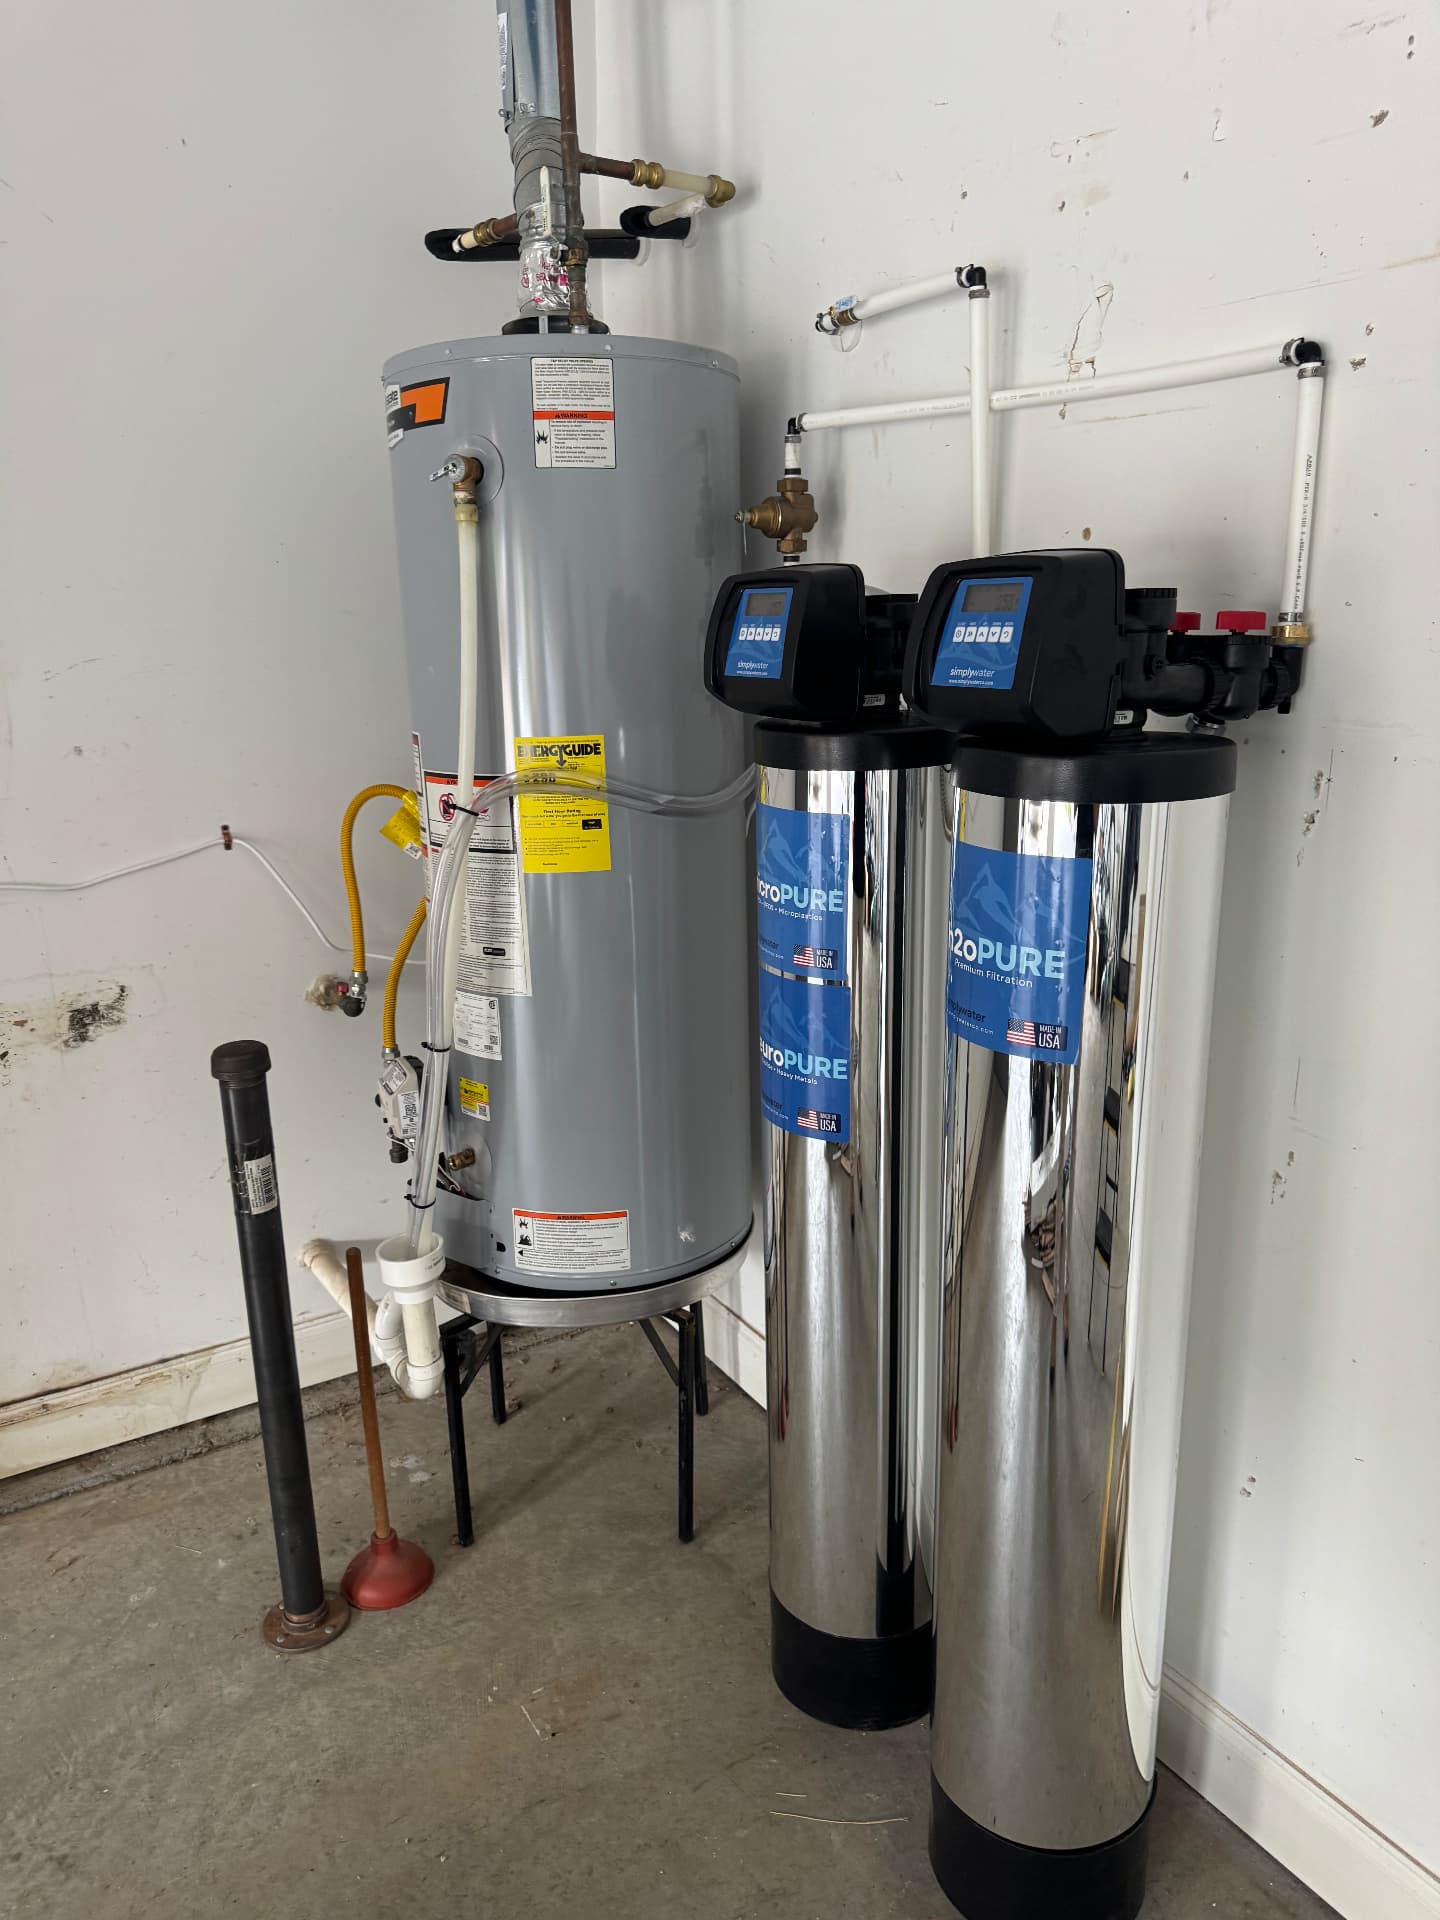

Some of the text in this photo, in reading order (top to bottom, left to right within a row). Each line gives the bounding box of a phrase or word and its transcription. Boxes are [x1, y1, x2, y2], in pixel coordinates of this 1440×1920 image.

[737, 660, 768, 670] simplywater
[949, 666, 996, 678] simplywater
[757, 872, 844, 912] icroPURE
[816, 956, 833, 969] USA
[954, 958, 1033, 988] Premium Filtration
[1038, 1034, 1060, 1049] USA
[760, 1036, 848, 1080] euroPURE
[776, 1067, 794, 1080] Heavy
[820, 1120, 837, 1132] USA
